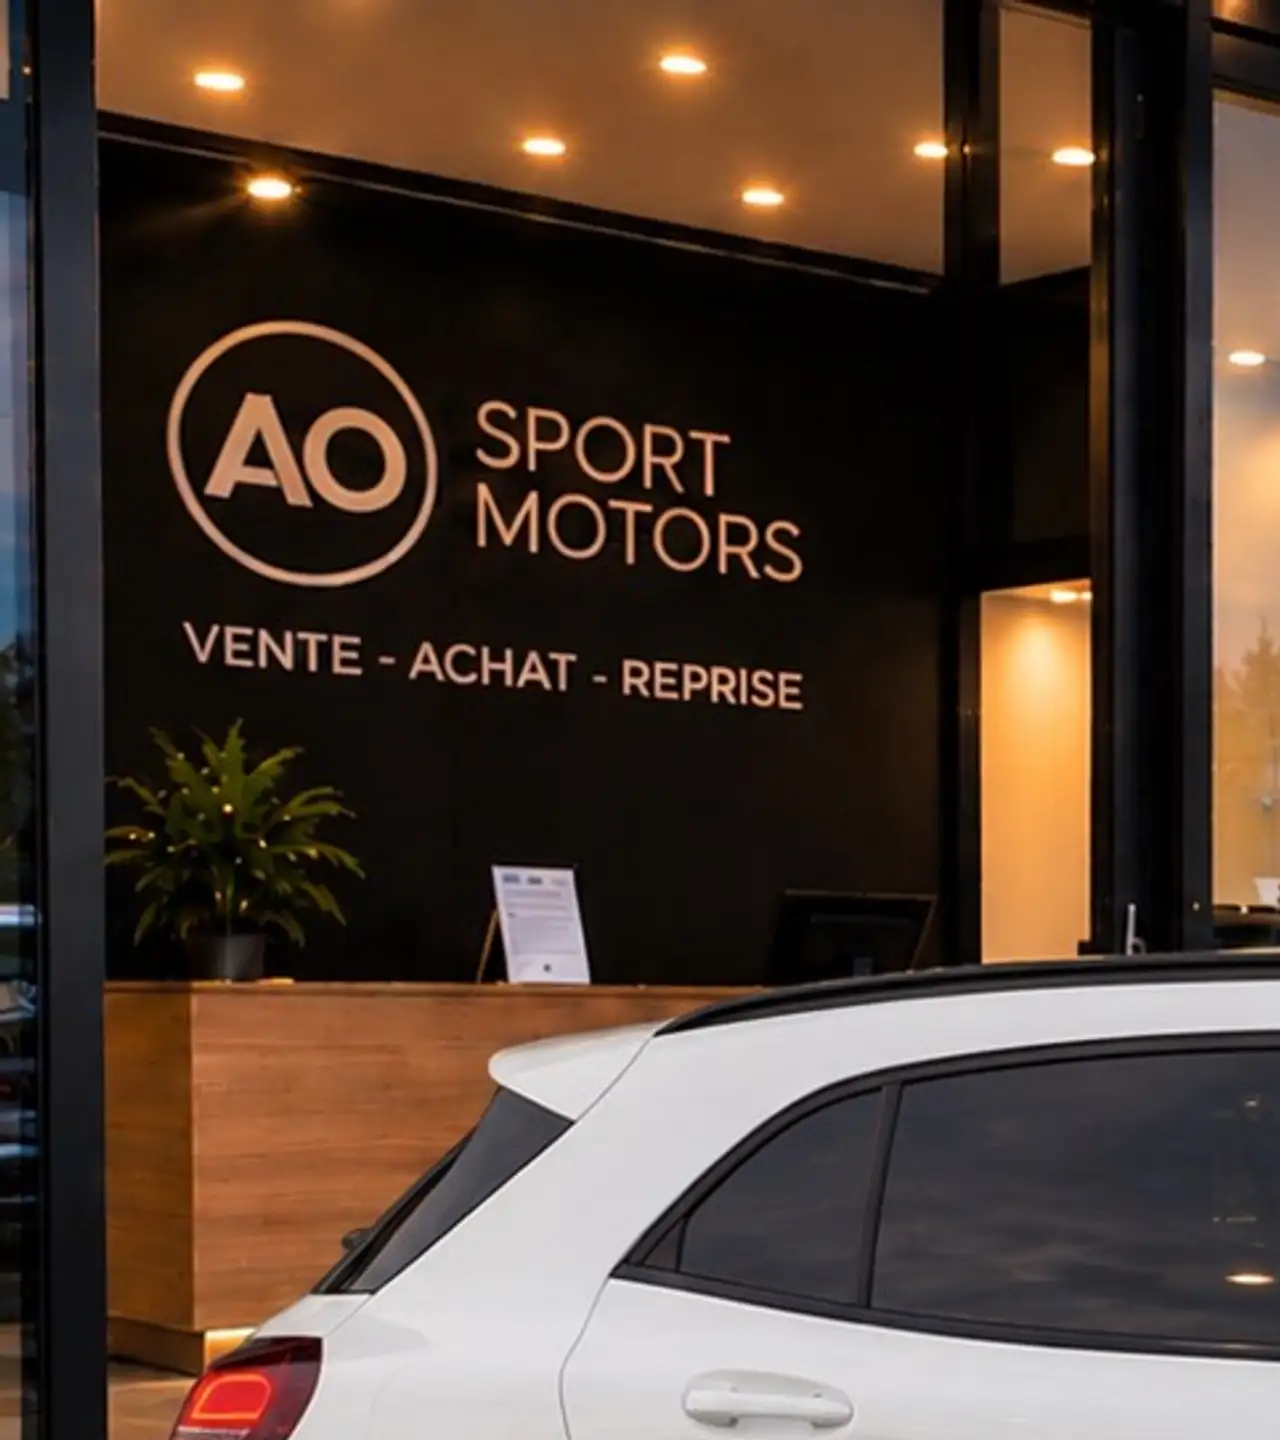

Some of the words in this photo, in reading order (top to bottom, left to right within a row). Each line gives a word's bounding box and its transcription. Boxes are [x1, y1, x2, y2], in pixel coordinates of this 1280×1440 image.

[203, 391, 407, 513] AO
[476, 400, 731, 497] SPORT
[476, 481, 804, 582] MOTORS
[182, 621, 363, 676] VENTE
[409, 641, 577, 692] ACHAT
[622, 658, 804, 710] REPRISE
